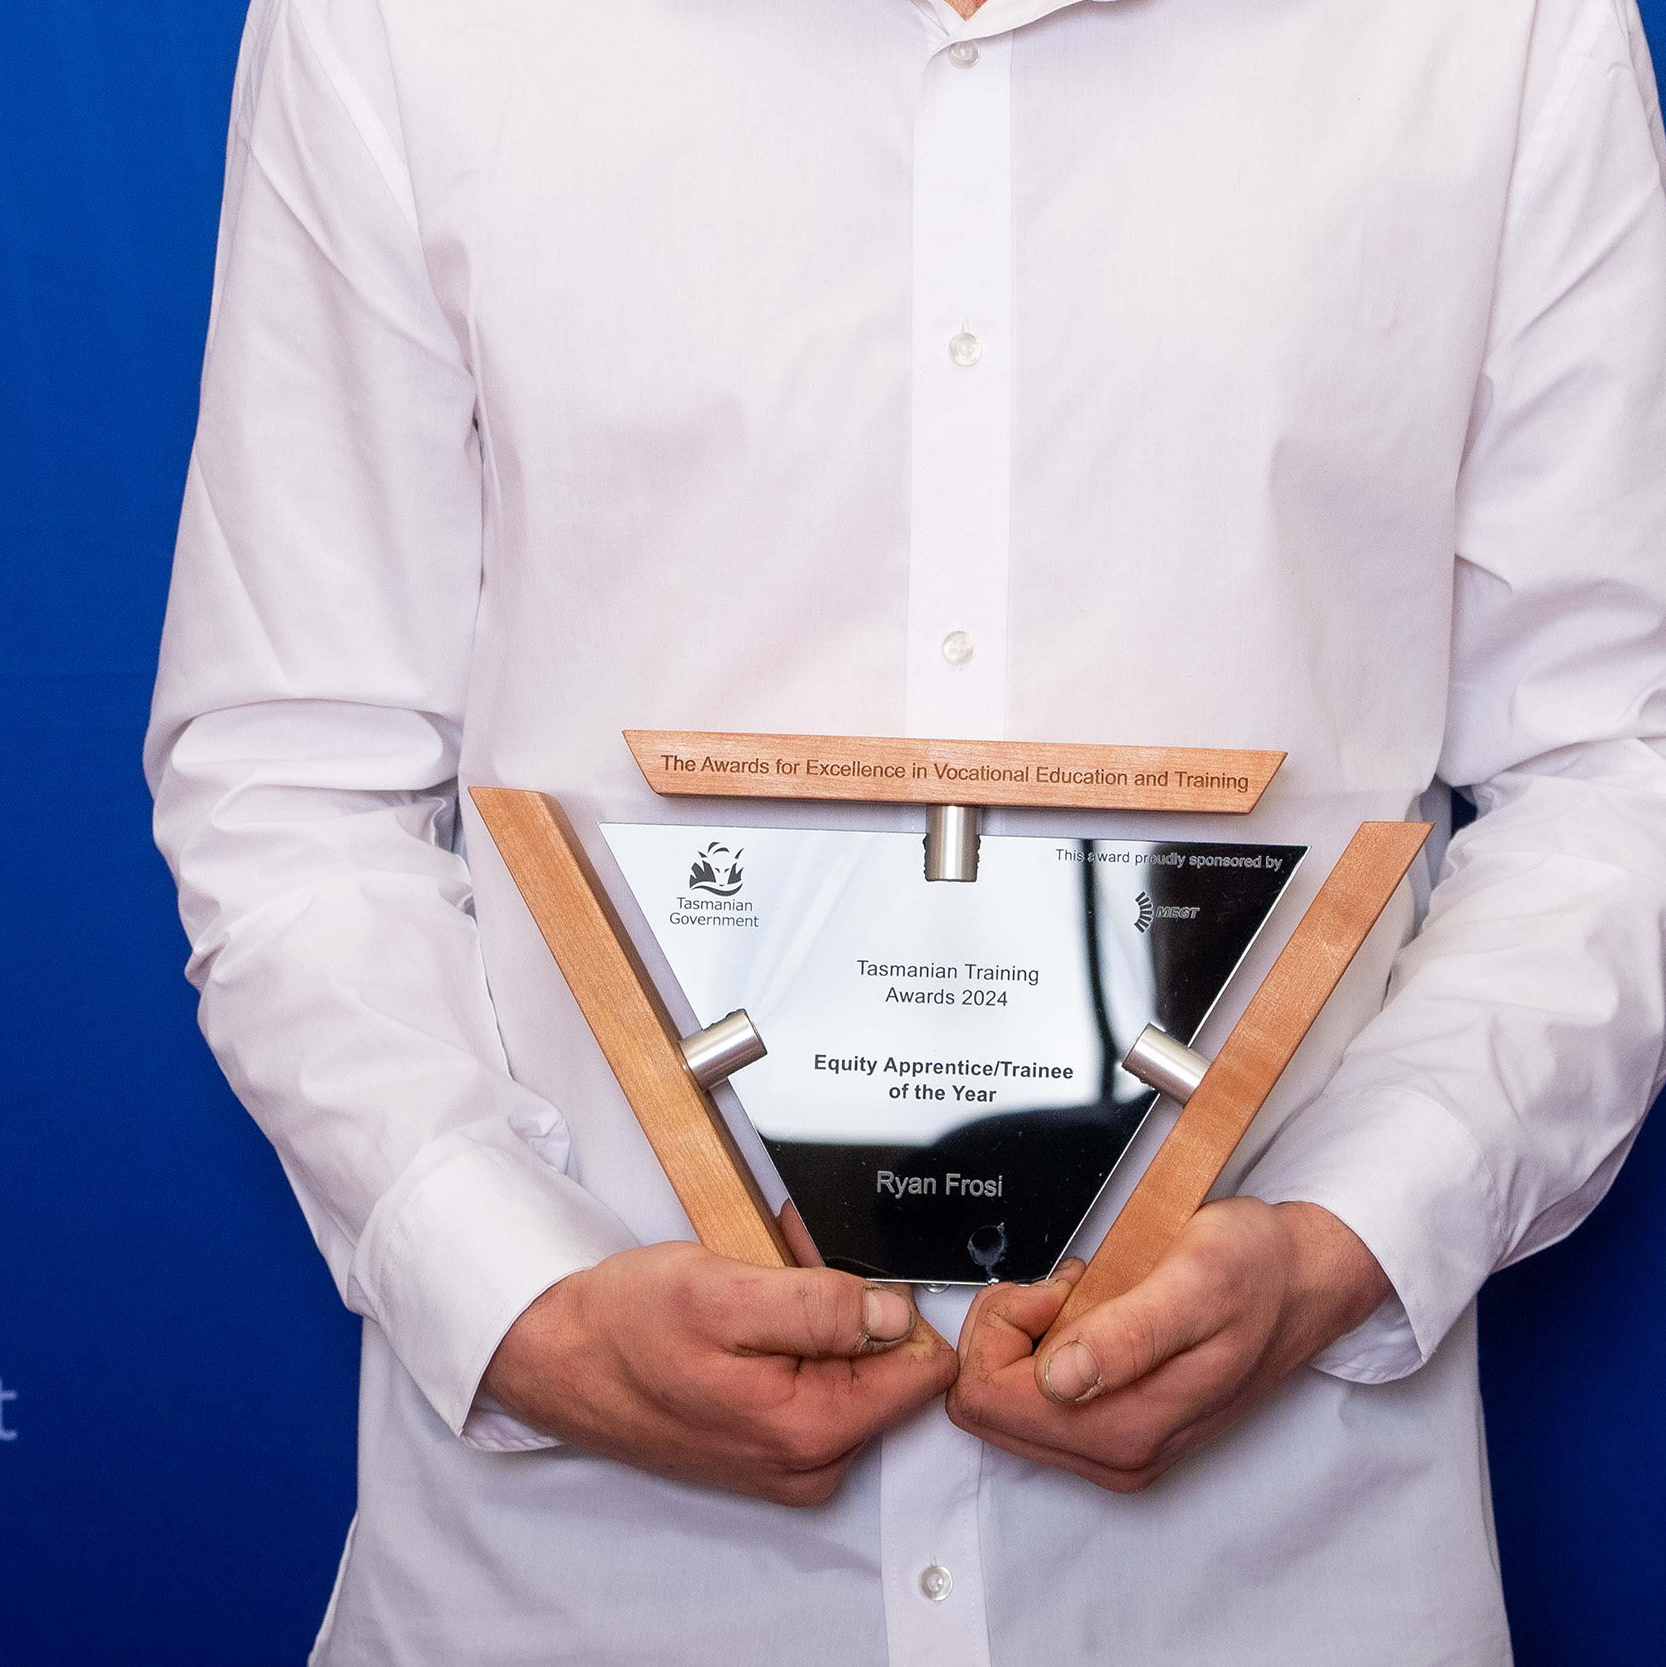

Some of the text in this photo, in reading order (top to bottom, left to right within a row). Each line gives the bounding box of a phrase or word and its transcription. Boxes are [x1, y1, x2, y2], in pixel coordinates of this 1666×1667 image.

[661, 754, 1249, 793] The Awards for Excellence in Vocational Education and Training
[1055, 848, 1284, 872] This award proudly sponsored by
[676, 896, 754, 912] Tasmanian
[1155, 905, 1201, 919] MEGT
[669, 912, 760, 928] Government
[856, 959, 1040, 986] Tasmanian Training
[885, 986, 1009, 1007] Awards 2024
[814, 1054, 1074, 1079] Equity Apprentice/Trainee
[889, 1083, 997, 1102] of the Year
[876, 1170, 1003, 1199] Ryan Frosi
